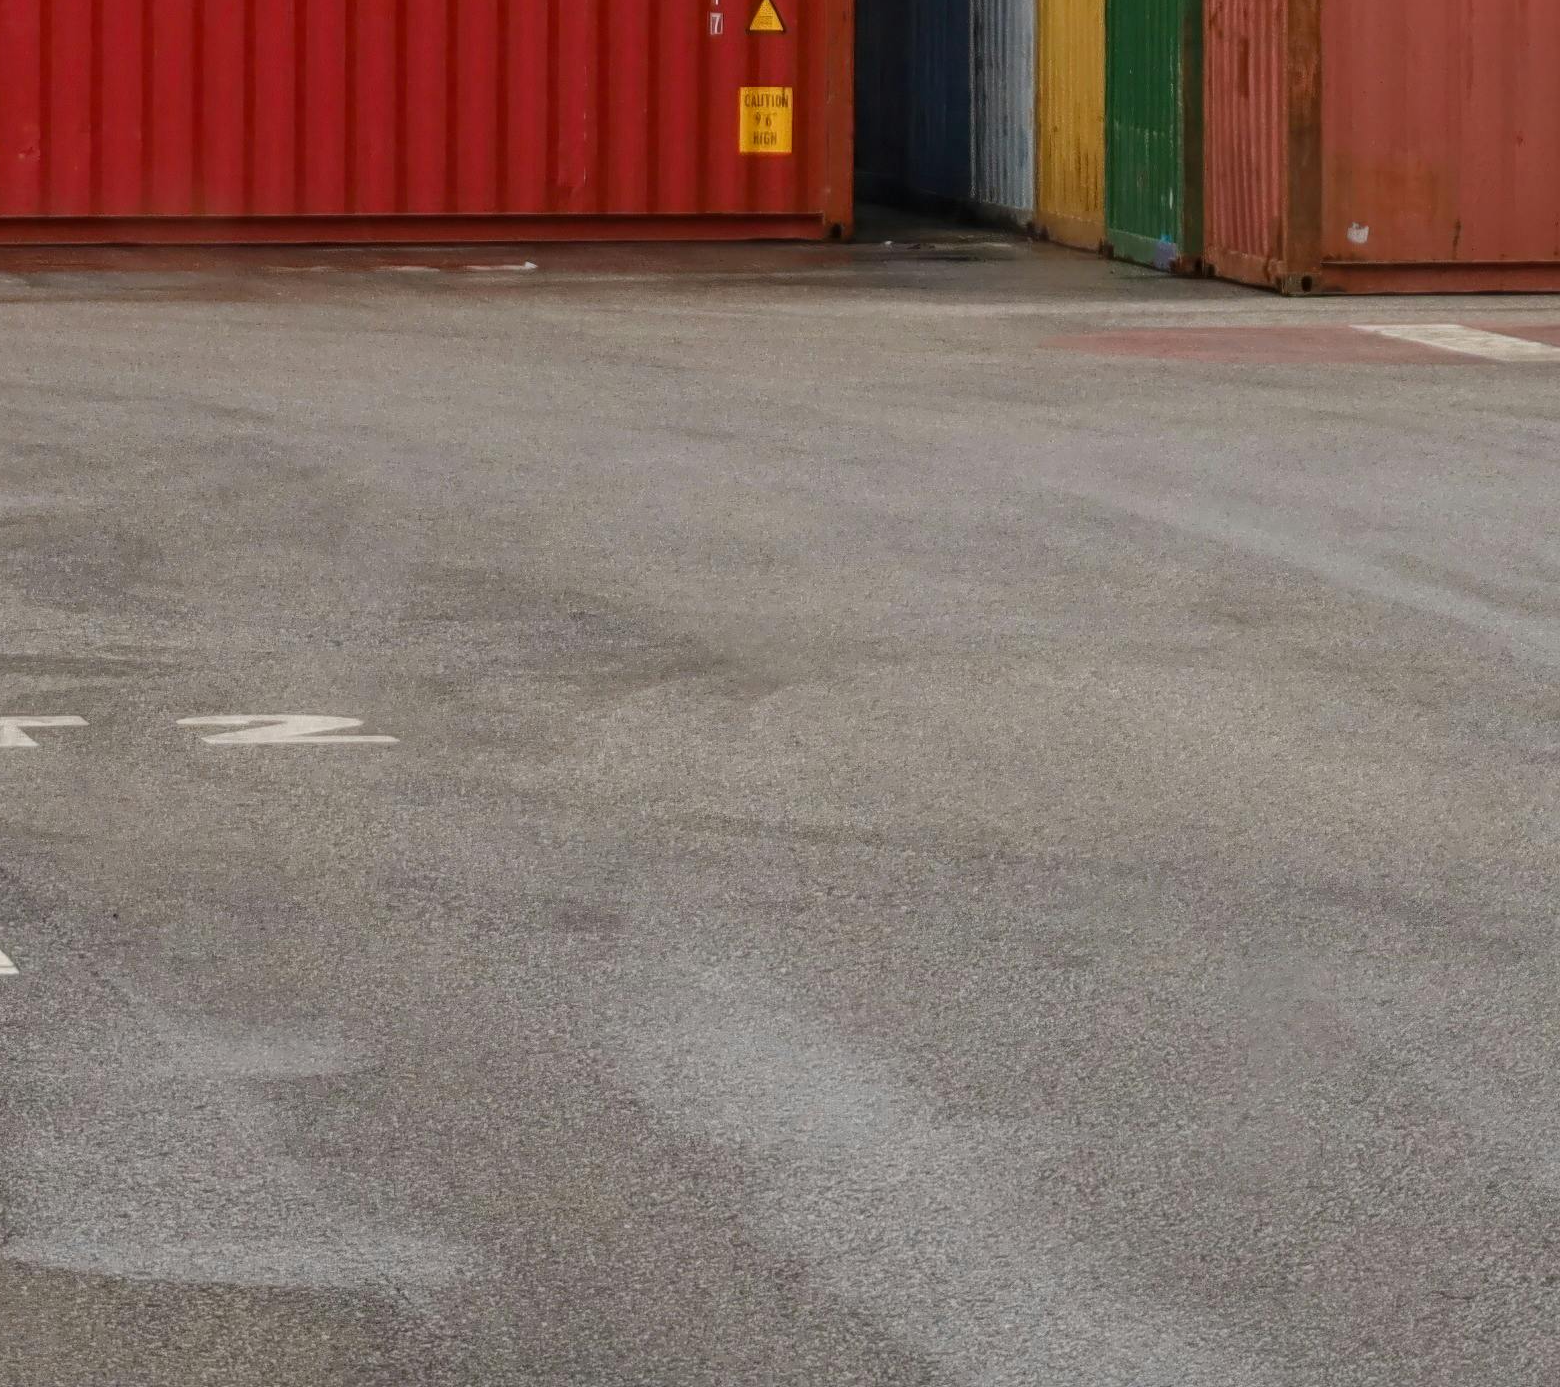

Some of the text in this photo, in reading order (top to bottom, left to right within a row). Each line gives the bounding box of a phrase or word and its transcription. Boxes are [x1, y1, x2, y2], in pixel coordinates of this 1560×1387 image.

[711, 14, 722, 35] 7
[744, 93, 789, 108] CAUTION
[752, 131, 777, 146] HIGH
